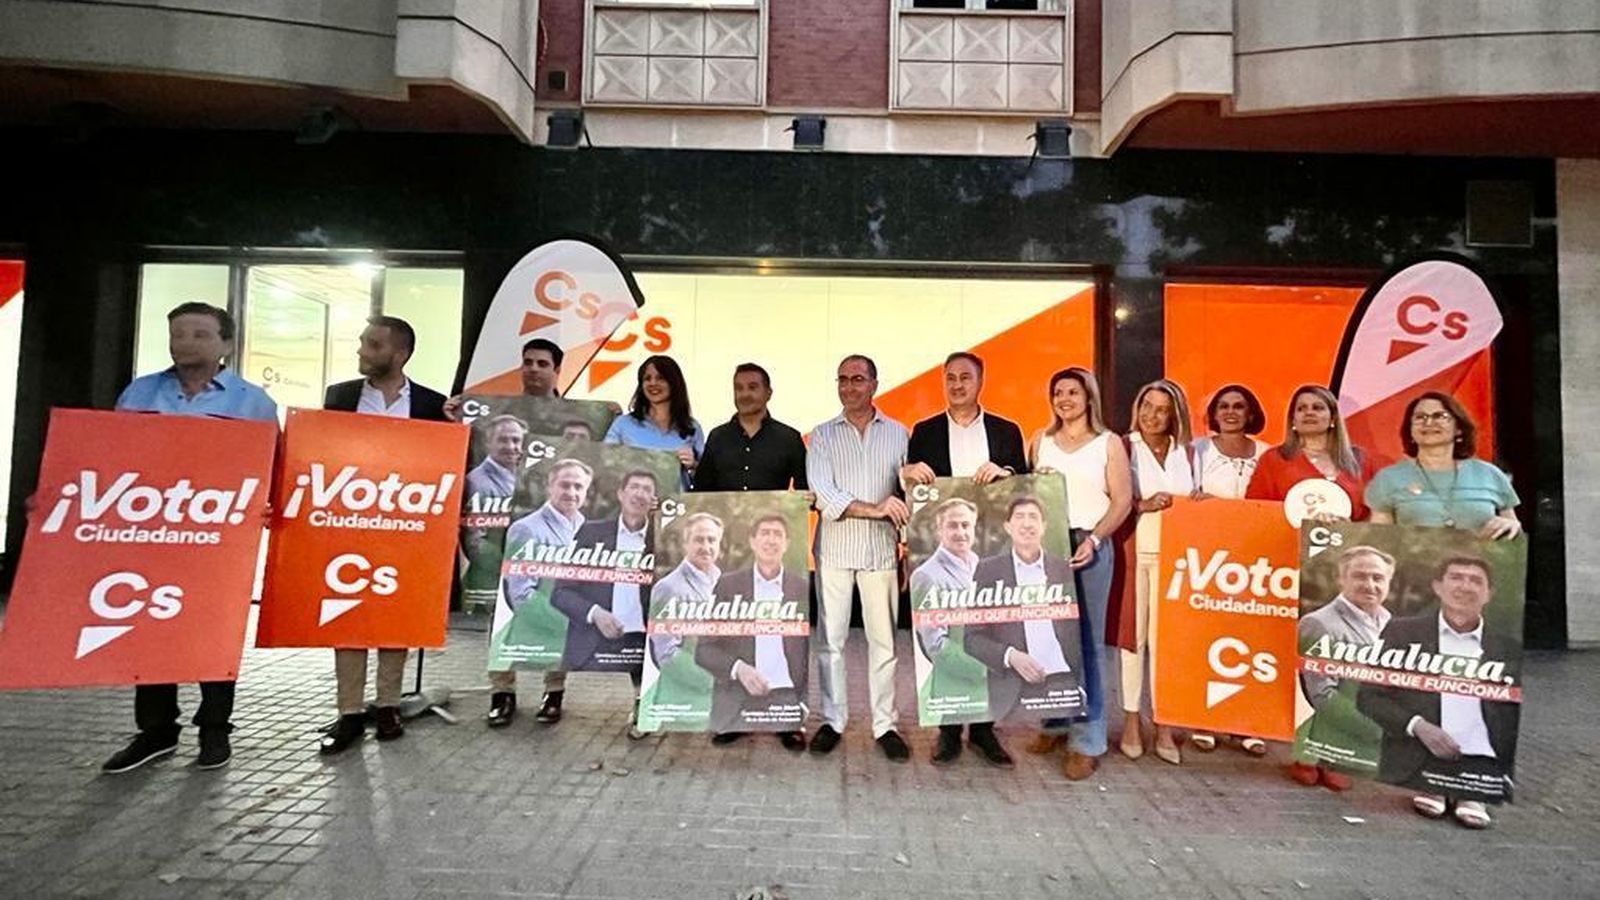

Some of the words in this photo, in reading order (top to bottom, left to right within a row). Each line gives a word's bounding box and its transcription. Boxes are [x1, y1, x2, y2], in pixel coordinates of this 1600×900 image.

[534, 270, 601, 320] Cs
[592, 303, 673, 353] Cs
[1397, 295, 1469, 340] Cs
[262, 366, 281, 383] Cs
[463, 400, 490, 416] Cs
[528, 440, 556, 458] Cs
[283, 463, 457, 519] ¡Vota!
[913, 484, 939, 502] Cs
[41, 470, 260, 535] ¡Vota!
[661, 498, 687, 516] Cs
[308, 510, 426, 532] Ciudadanos
[74, 523, 221, 545] Ciudadanos
[1309, 527, 1343, 546] Cs
[324, 553, 399, 595] Cs
[509, 563, 525, 575] EL
[527, 565, 575, 578] CAMBIO
[577, 568, 600, 580] QUE
[89, 571, 184, 619] Cs
[1189, 593, 1299, 619] Ciudadanos
[920, 613, 932, 625] EL
[935, 610, 982, 624] CAMBIO
[984, 609, 1008, 621] QUE
[1011, 606, 1072, 620] FUNCIONA
[655, 623, 667, 634] EL
[670, 623, 717, 635] CAMBIO
[719, 623, 741, 634] QUE
[744, 623, 802, 635] FUNCIONA
[1208, 637, 1278, 683] Cs
[1304, 661, 1321, 672] EL
[1324, 664, 1385, 682] CAMBIO
[1388, 673, 1420, 687] QUE
[1424, 677, 1511, 699] FUNCIONA
